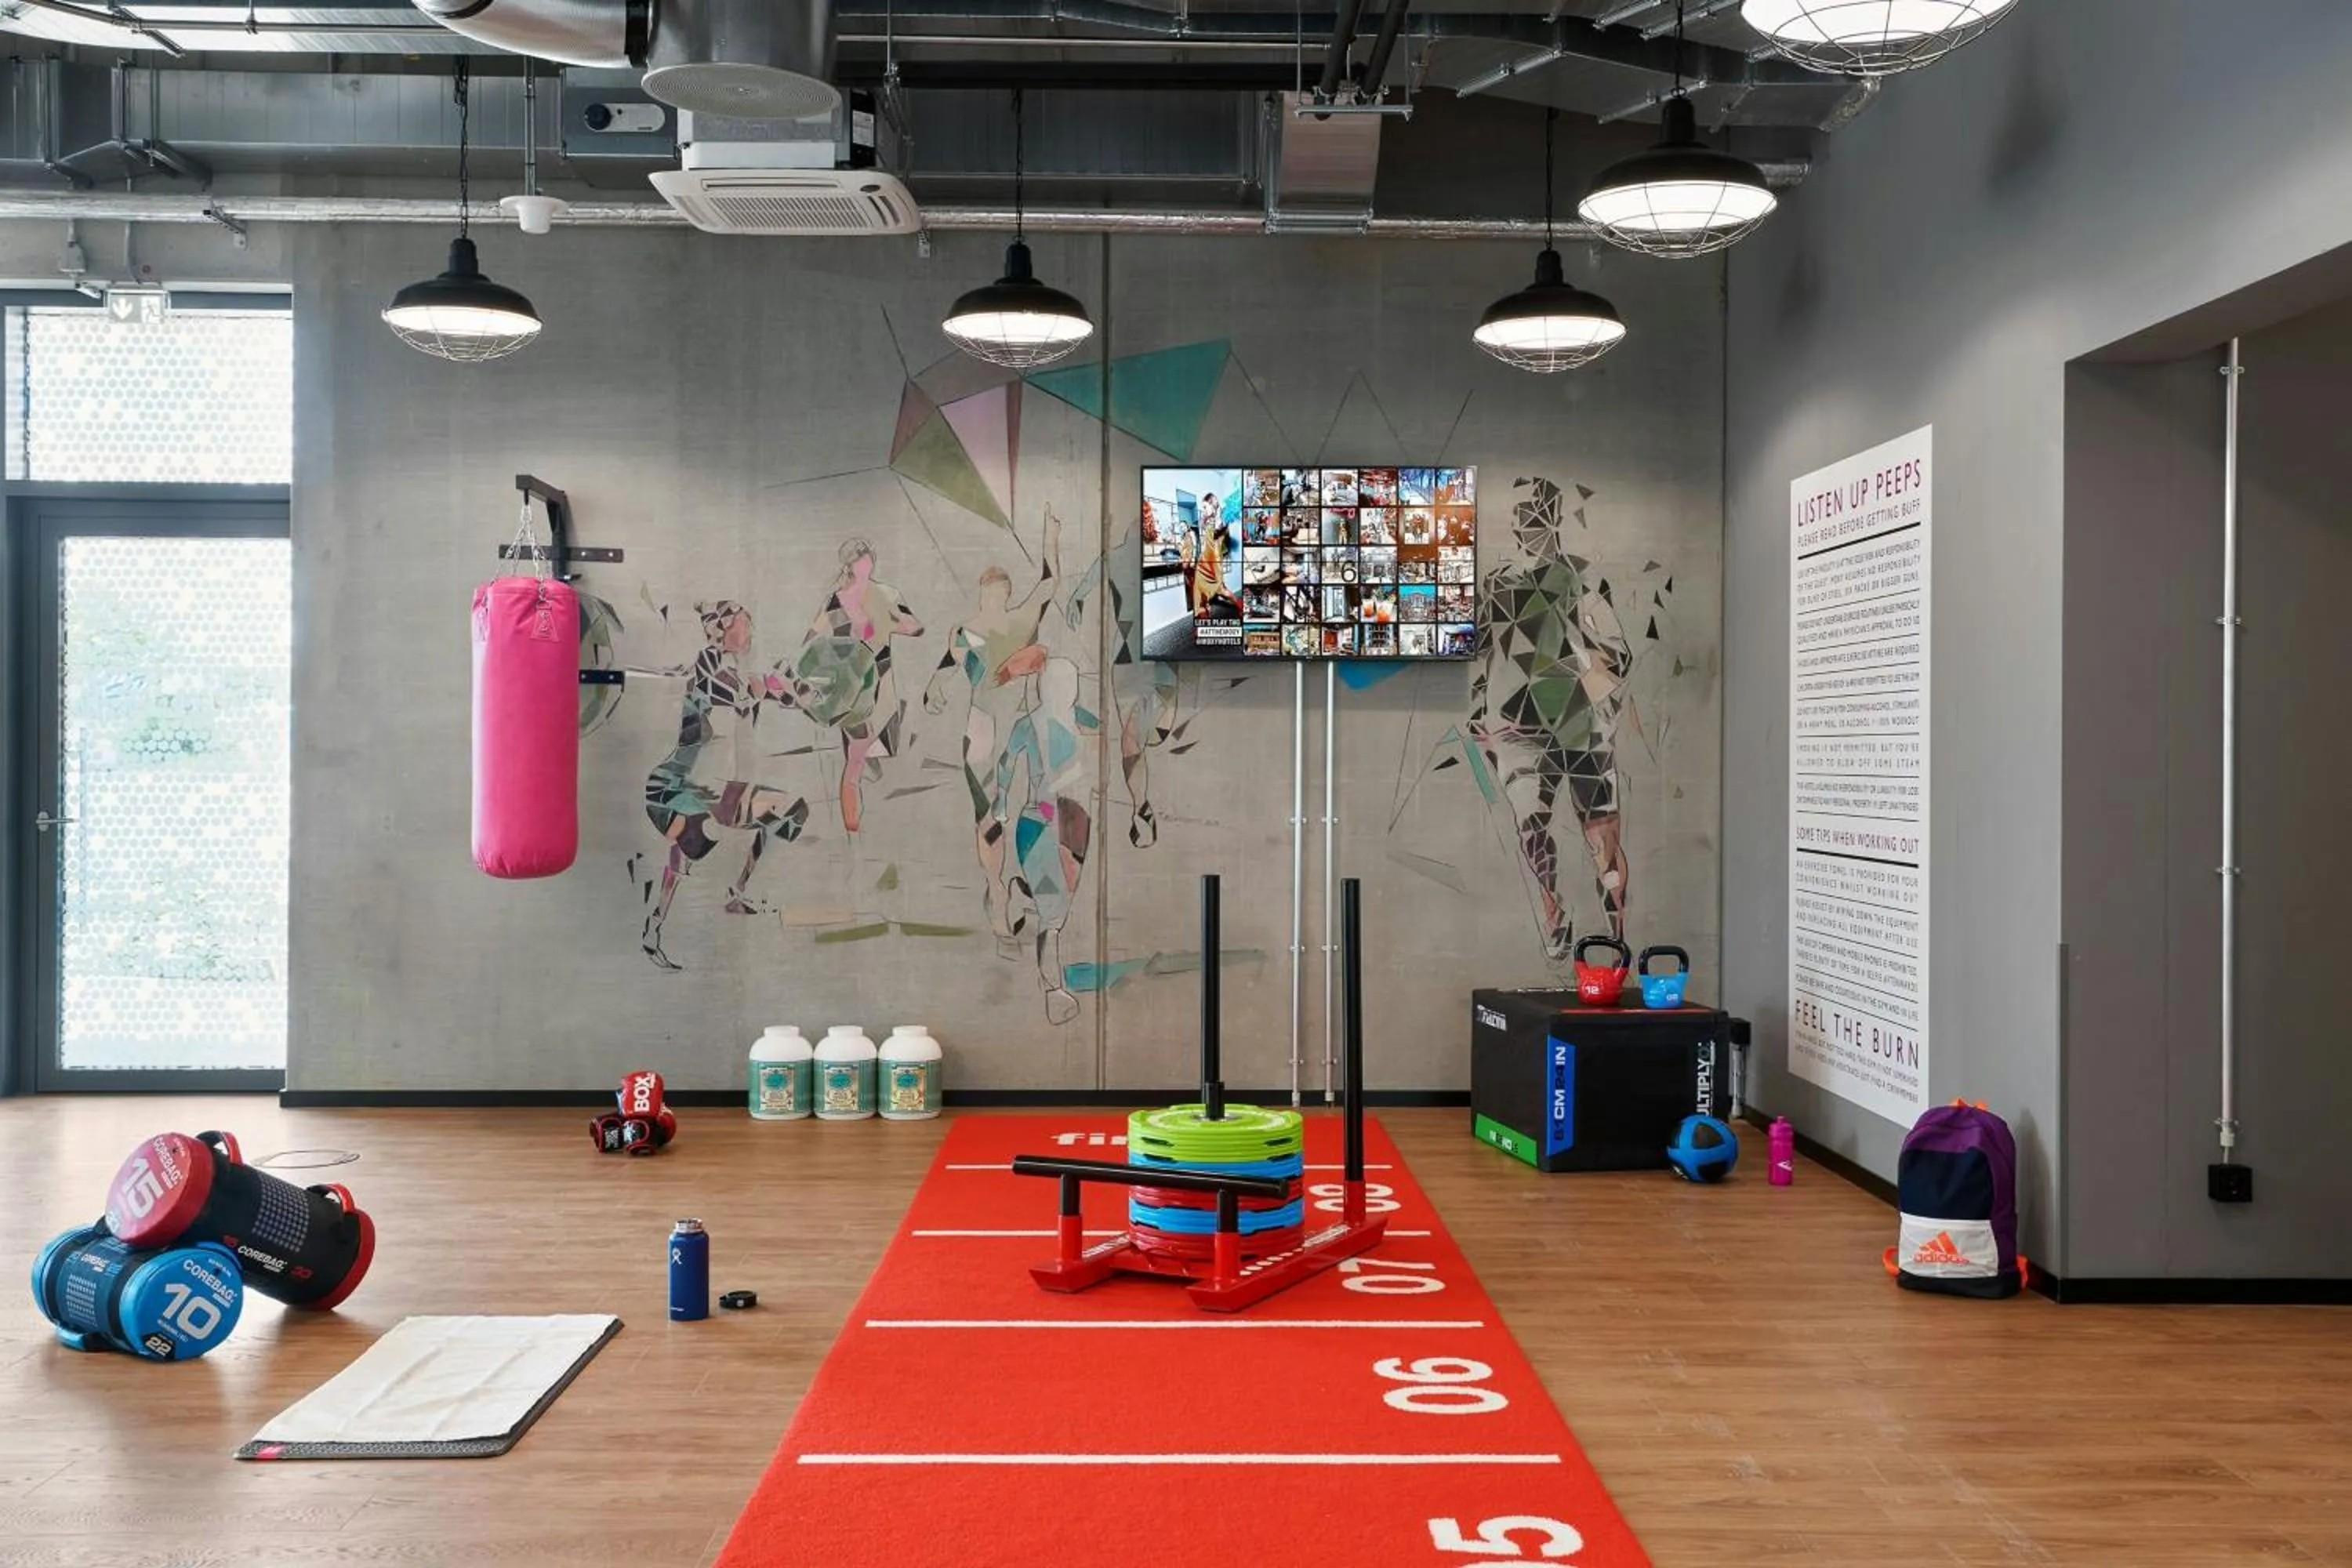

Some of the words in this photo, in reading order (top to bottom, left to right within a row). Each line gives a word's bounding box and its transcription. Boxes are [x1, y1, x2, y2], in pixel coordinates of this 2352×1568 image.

[1797, 486, 1842, 528] LISTEN
[1849, 477, 1868, 510] UP
[1876, 457, 1921, 501] PEEPS
[1797, 528, 1819, 550] PLEASE
[1820, 523, 1836, 543] READ
[1838, 514, 1864, 536] BEFORE
[1867, 503, 1900, 528] GETTING
[1901, 497, 1920, 517] BUFF
[1341, 561, 1356, 583] 6
[1795, 826, 1814, 843] SOME
[1816, 828, 1831, 844] TIPS
[1831, 829, 1855, 848] WHEN
[1857, 832, 1896, 853] WORKING
[1900, 837, 1919, 855] OUT
[1585, 985, 1599, 994] 12
[1795, 998, 1825, 1034] FEEL
[1833, 1012, 1862, 1049] THE
[1872, 1025, 1919, 1071] BURN
[633, 1076, 650, 1112] BOX
[154, 1137, 182, 1185] COREBAG
[122, 1157, 164, 1218] 15
[1308, 1184, 1402, 1213] 08
[238, 1245, 285, 1268] COREBAG
[1337, 1257, 1446, 1294] 07
[1912, 1252, 1970, 1265] adidas
[183, 1259, 234, 1303] COREBAG
[165, 1283, 222, 1340] 10
[145, 1336, 172, 1357] 22
[1373, 1357, 1508, 1414] 06
[1427, 1515, 1584, 1568] 5
